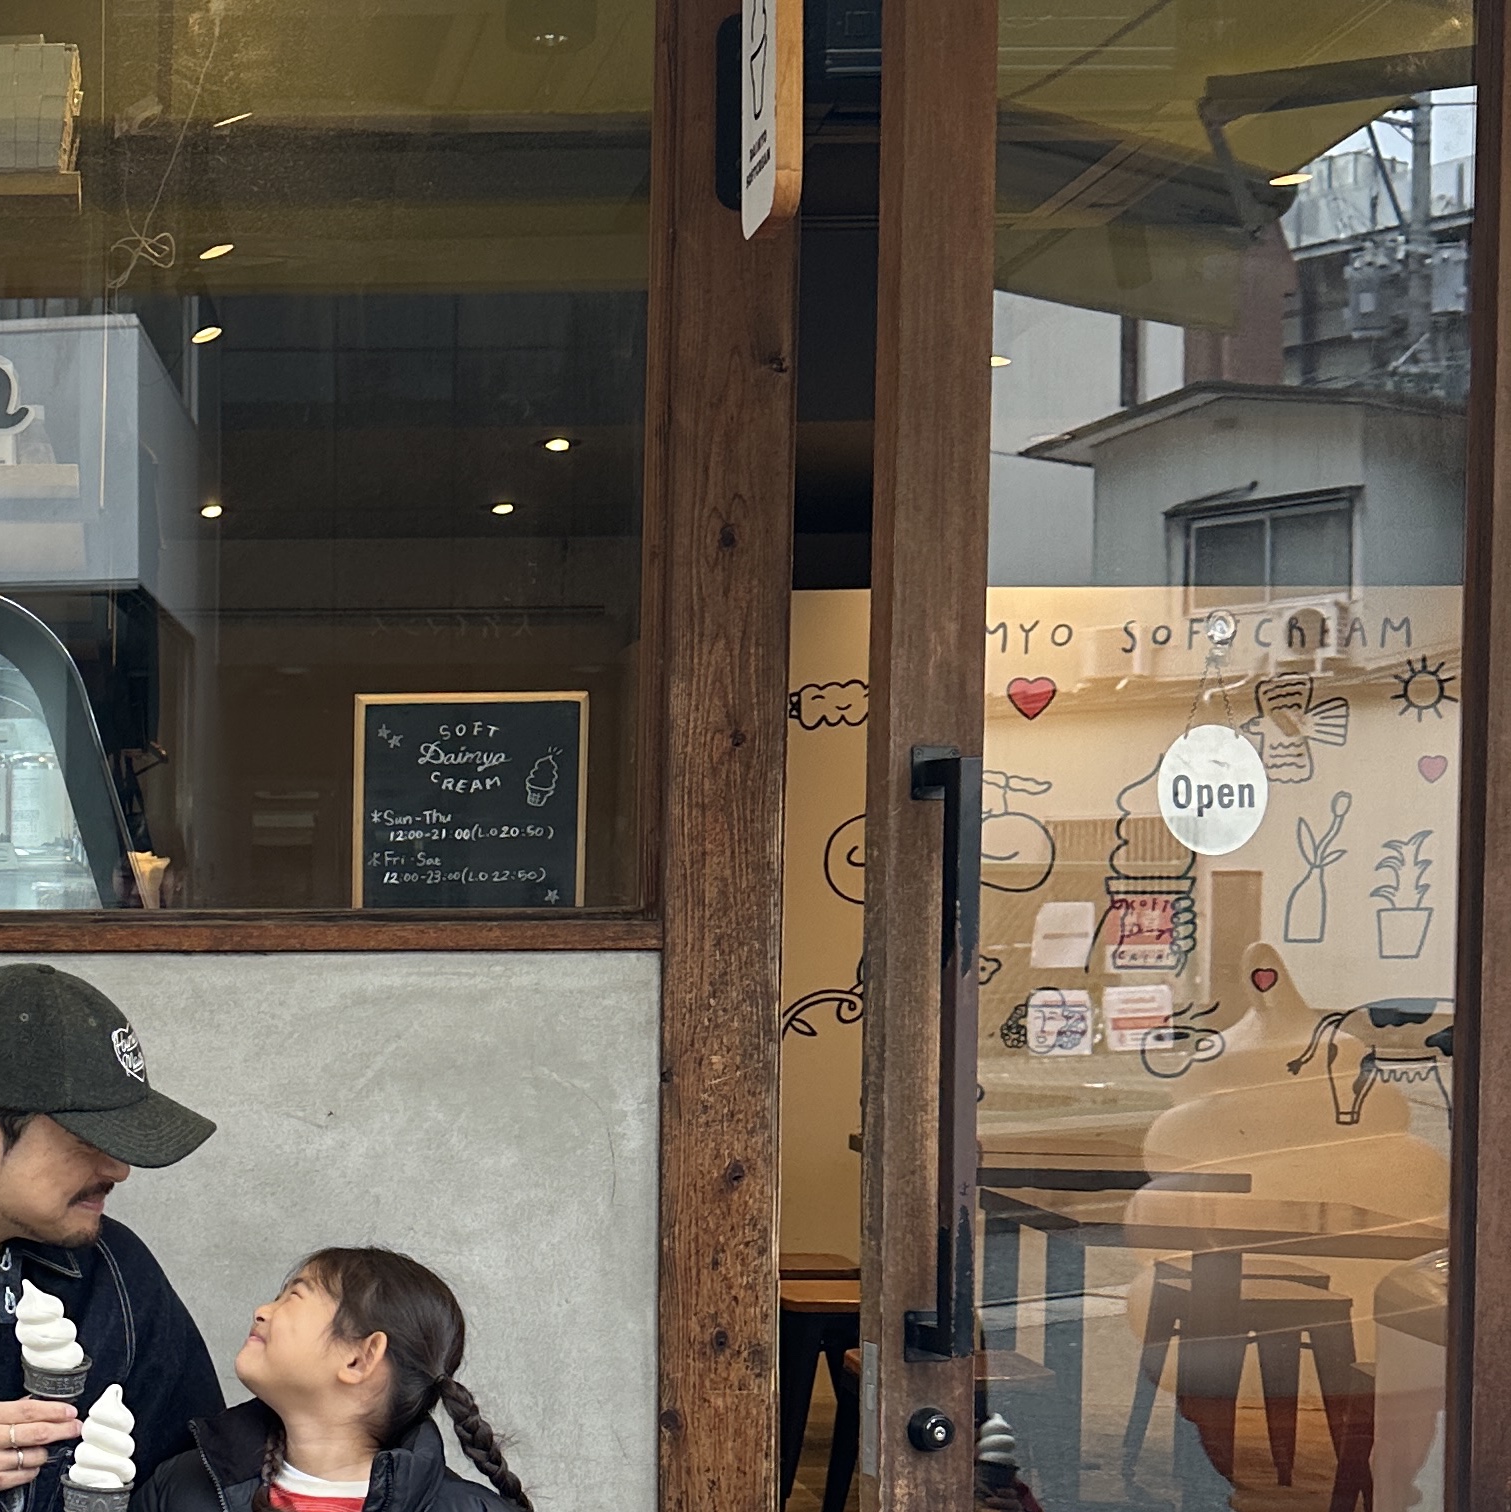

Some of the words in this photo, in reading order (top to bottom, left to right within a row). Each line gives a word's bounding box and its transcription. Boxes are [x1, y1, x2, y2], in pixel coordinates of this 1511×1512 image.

[438, 721, 500, 741] SOFT
[417, 741, 512, 772] Daimyo
[430, 771, 502, 794] CREAM
[1172, 774, 1255, 817] Open
